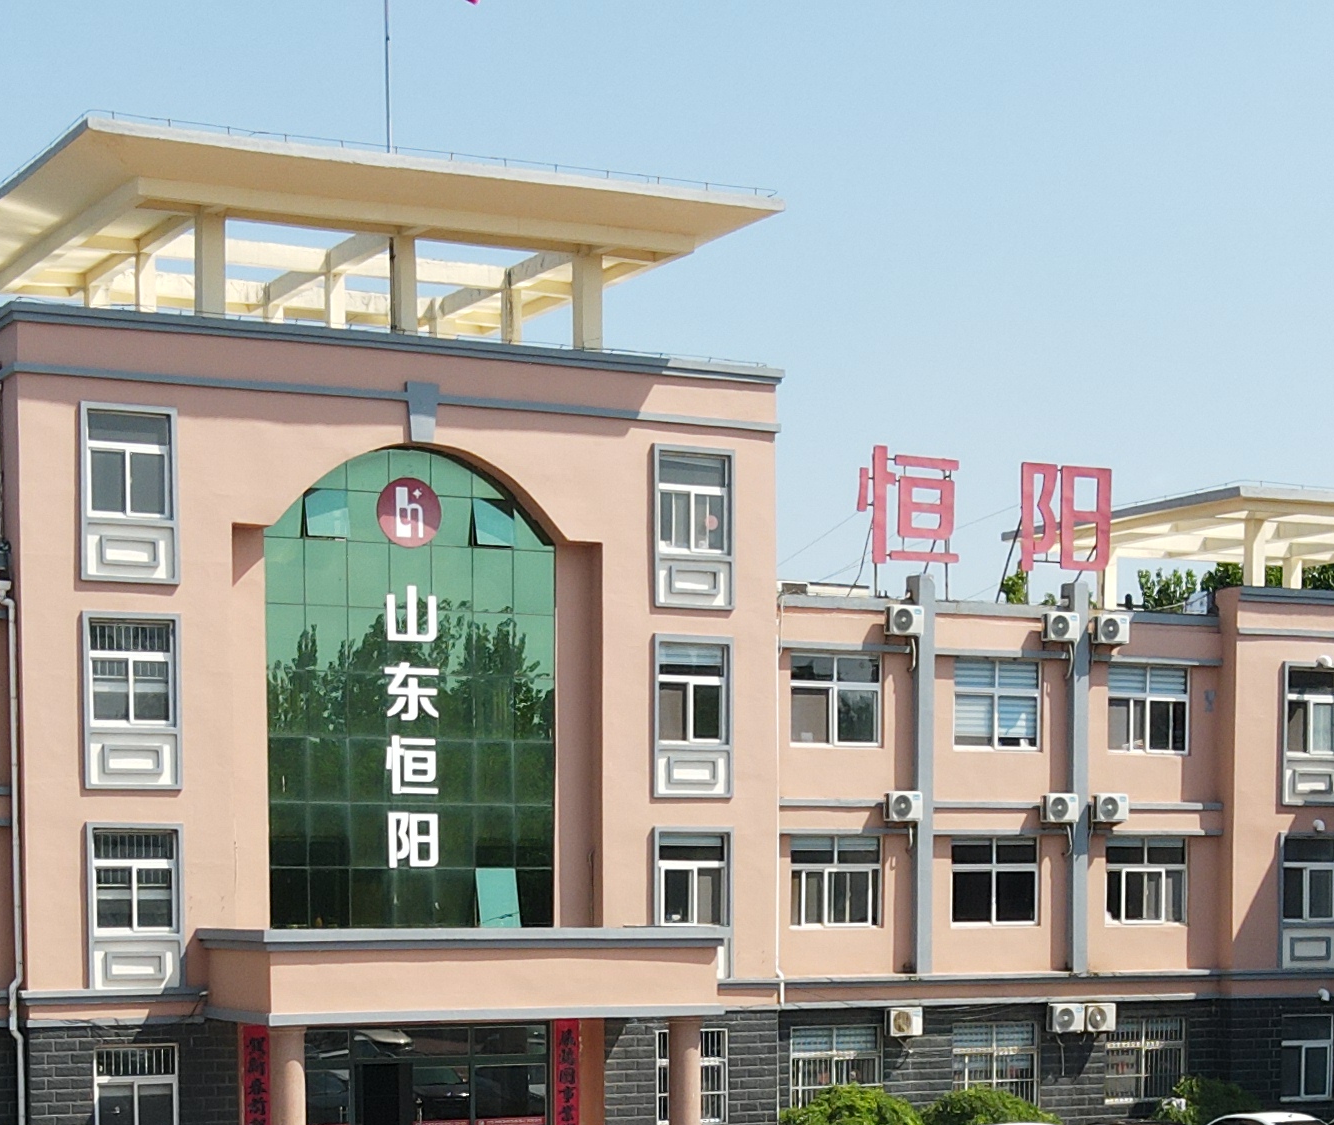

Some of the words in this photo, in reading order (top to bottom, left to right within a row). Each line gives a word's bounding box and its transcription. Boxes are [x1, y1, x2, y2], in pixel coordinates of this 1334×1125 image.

[856, 444, 1113, 572] 恒阳
[383, 585, 440, 869] 山东恒阳
